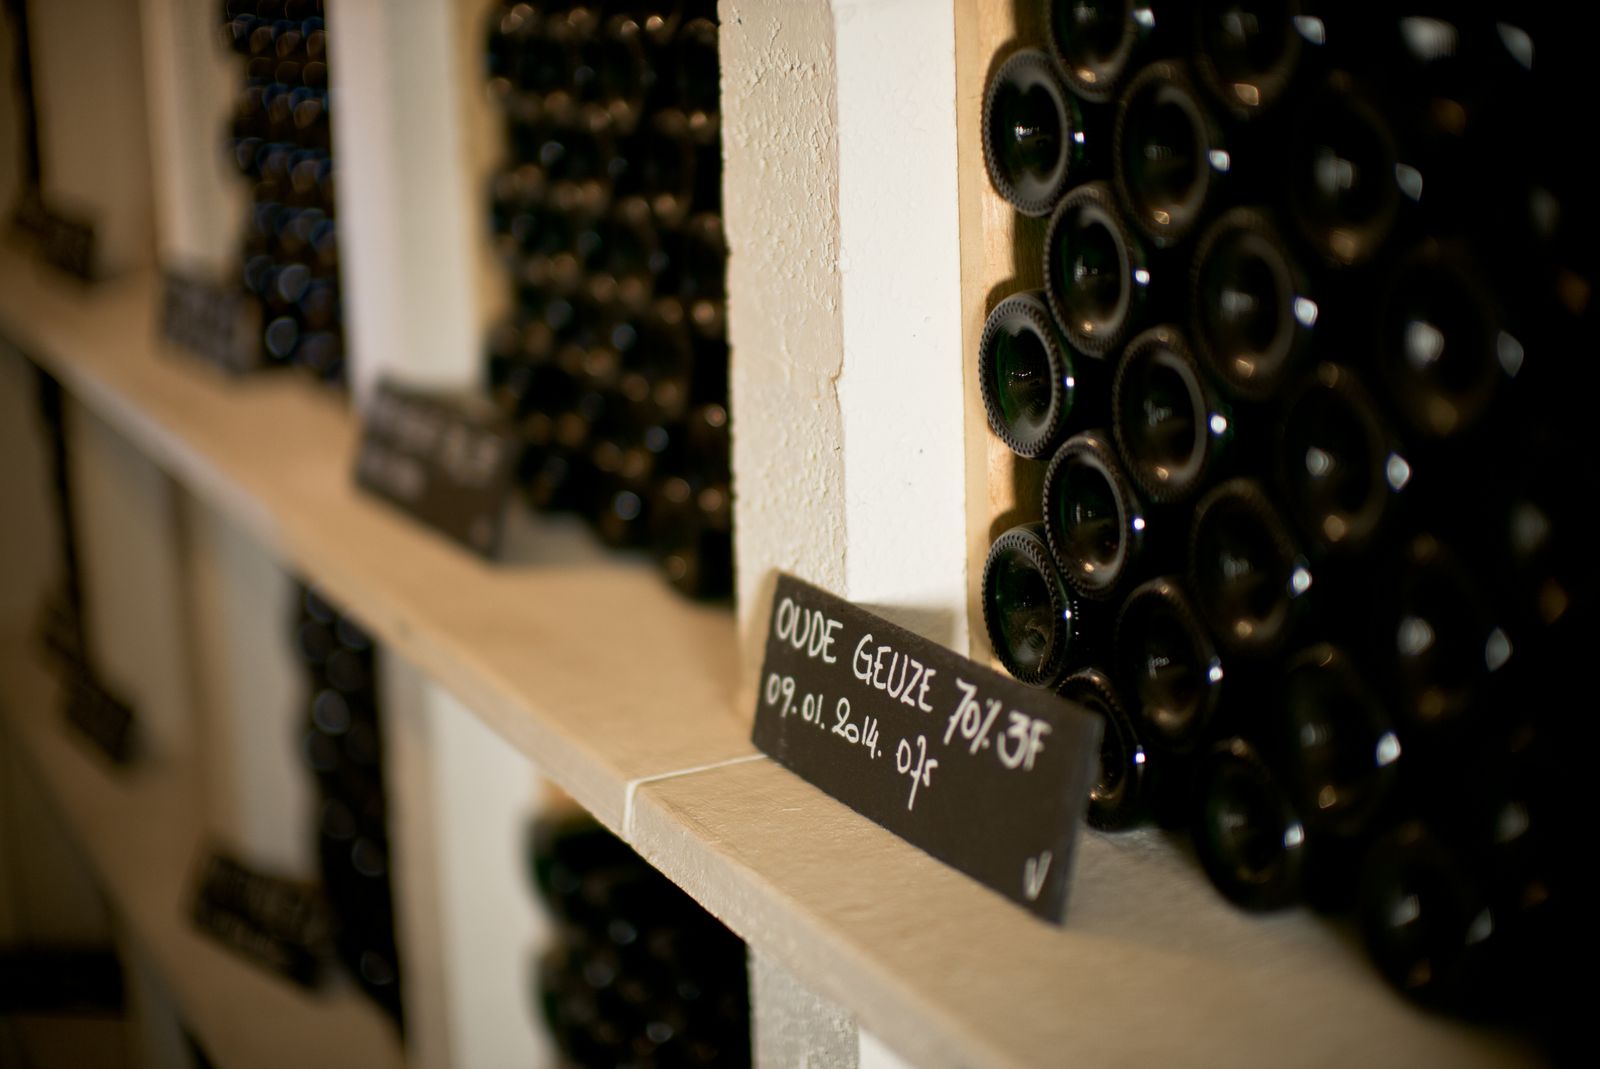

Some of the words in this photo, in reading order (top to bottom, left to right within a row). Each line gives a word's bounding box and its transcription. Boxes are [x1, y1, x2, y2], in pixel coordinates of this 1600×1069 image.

[775, 597, 843, 664] OUDE
[853, 634, 936, 713] GEUZE
[997, 710, 1052, 771] 3F
